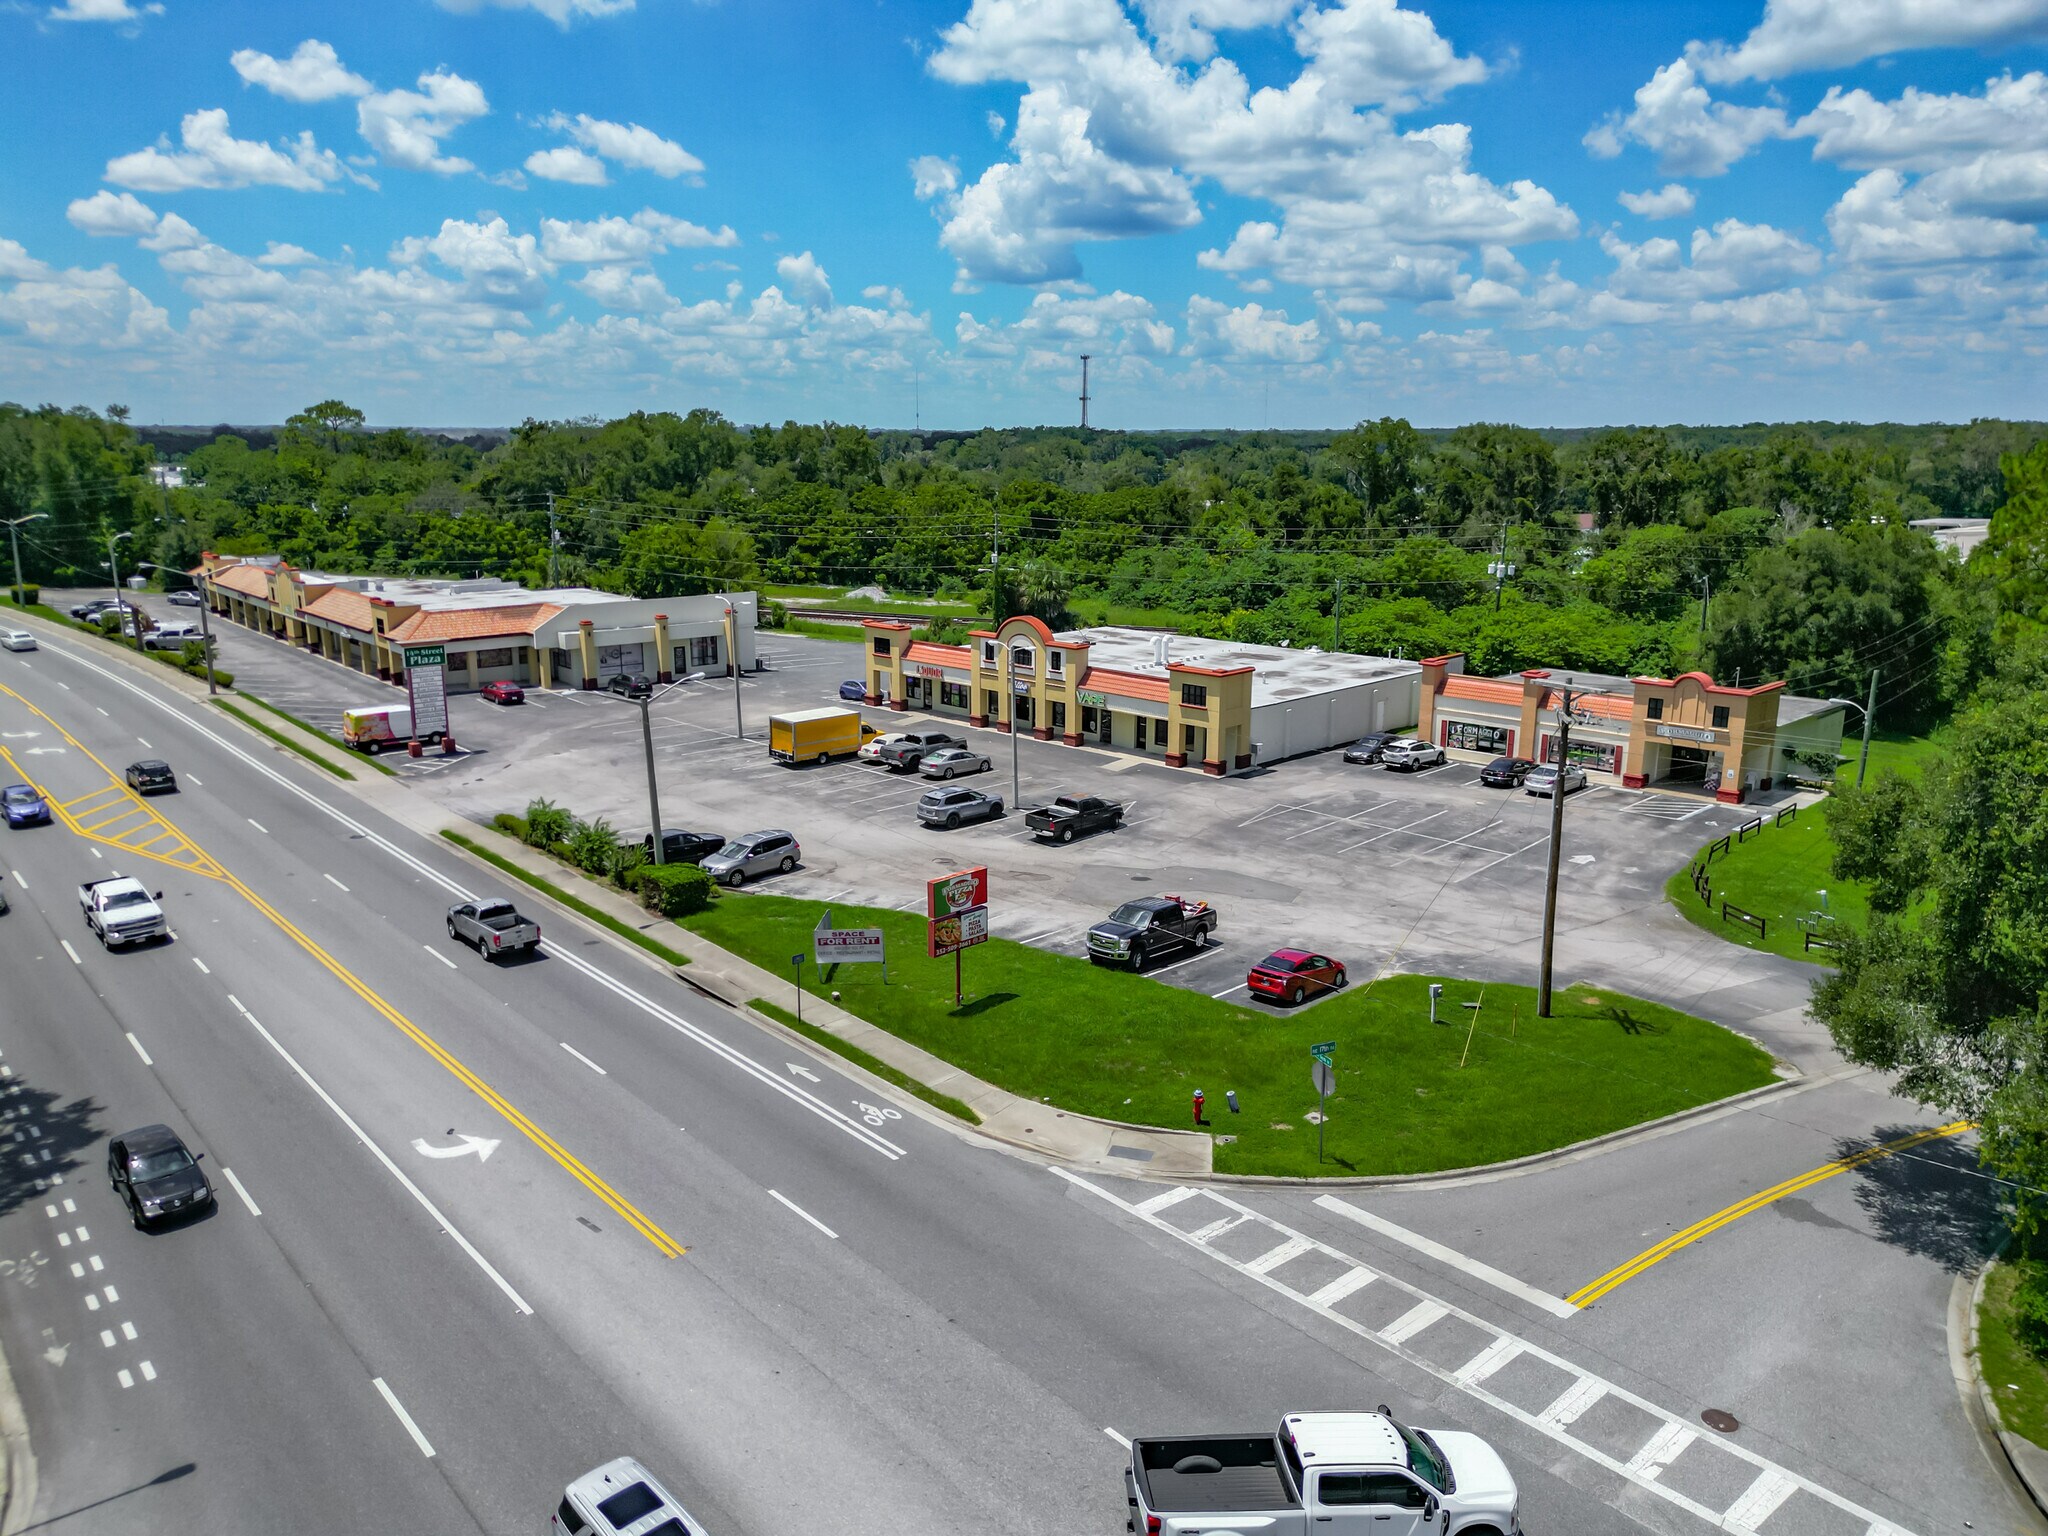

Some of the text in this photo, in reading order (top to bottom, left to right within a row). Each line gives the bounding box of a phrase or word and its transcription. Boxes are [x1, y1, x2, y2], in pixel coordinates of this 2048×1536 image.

[421, 648, 444, 656] Street
[410, 655, 441, 665] Plaza
[916, 665, 943, 678] LIQUOR
[1076, 691, 1106, 707] VAPE
[1457, 724, 1500, 740] FORMAGGIO
[949, 885, 972, 897] PIZZA
[968, 928, 985, 937] SALADS
[846, 937, 878, 945] RENT
